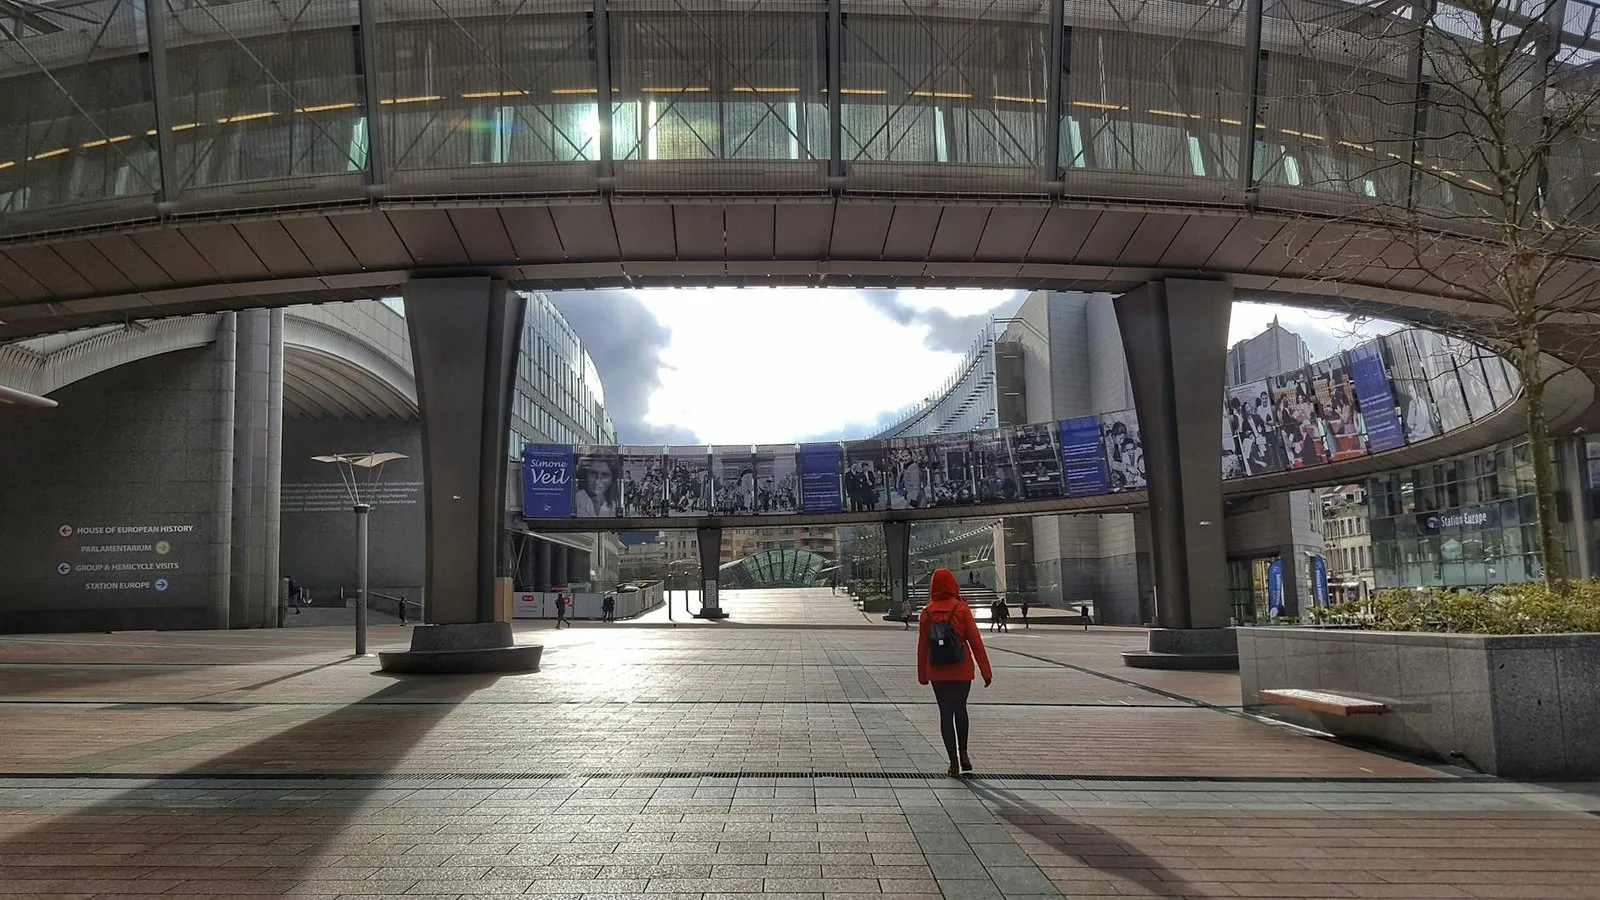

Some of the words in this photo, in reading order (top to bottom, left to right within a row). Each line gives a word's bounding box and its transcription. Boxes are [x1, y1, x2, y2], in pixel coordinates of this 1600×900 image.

[530, 459, 568, 468] Simone
[531, 468, 570, 484] Veil
[1440, 515, 1463, 527] Station
[1463, 512, 1487, 525] Europe
[77, 526, 104, 535] HOUSE
[105, 526, 116, 534] OF
[117, 525, 160, 534] EUROPEAN
[160, 525, 194, 533] HISTORY
[81, 544, 152, 553] PARLAMENTARIUM
[75, 564, 103, 572] GROUP
[112, 563, 154, 571] HEMICYCLE
[155, 562, 180, 570] VISITS
[85, 581, 118, 590] STATION
[119, 581, 151, 589] EUROPE
